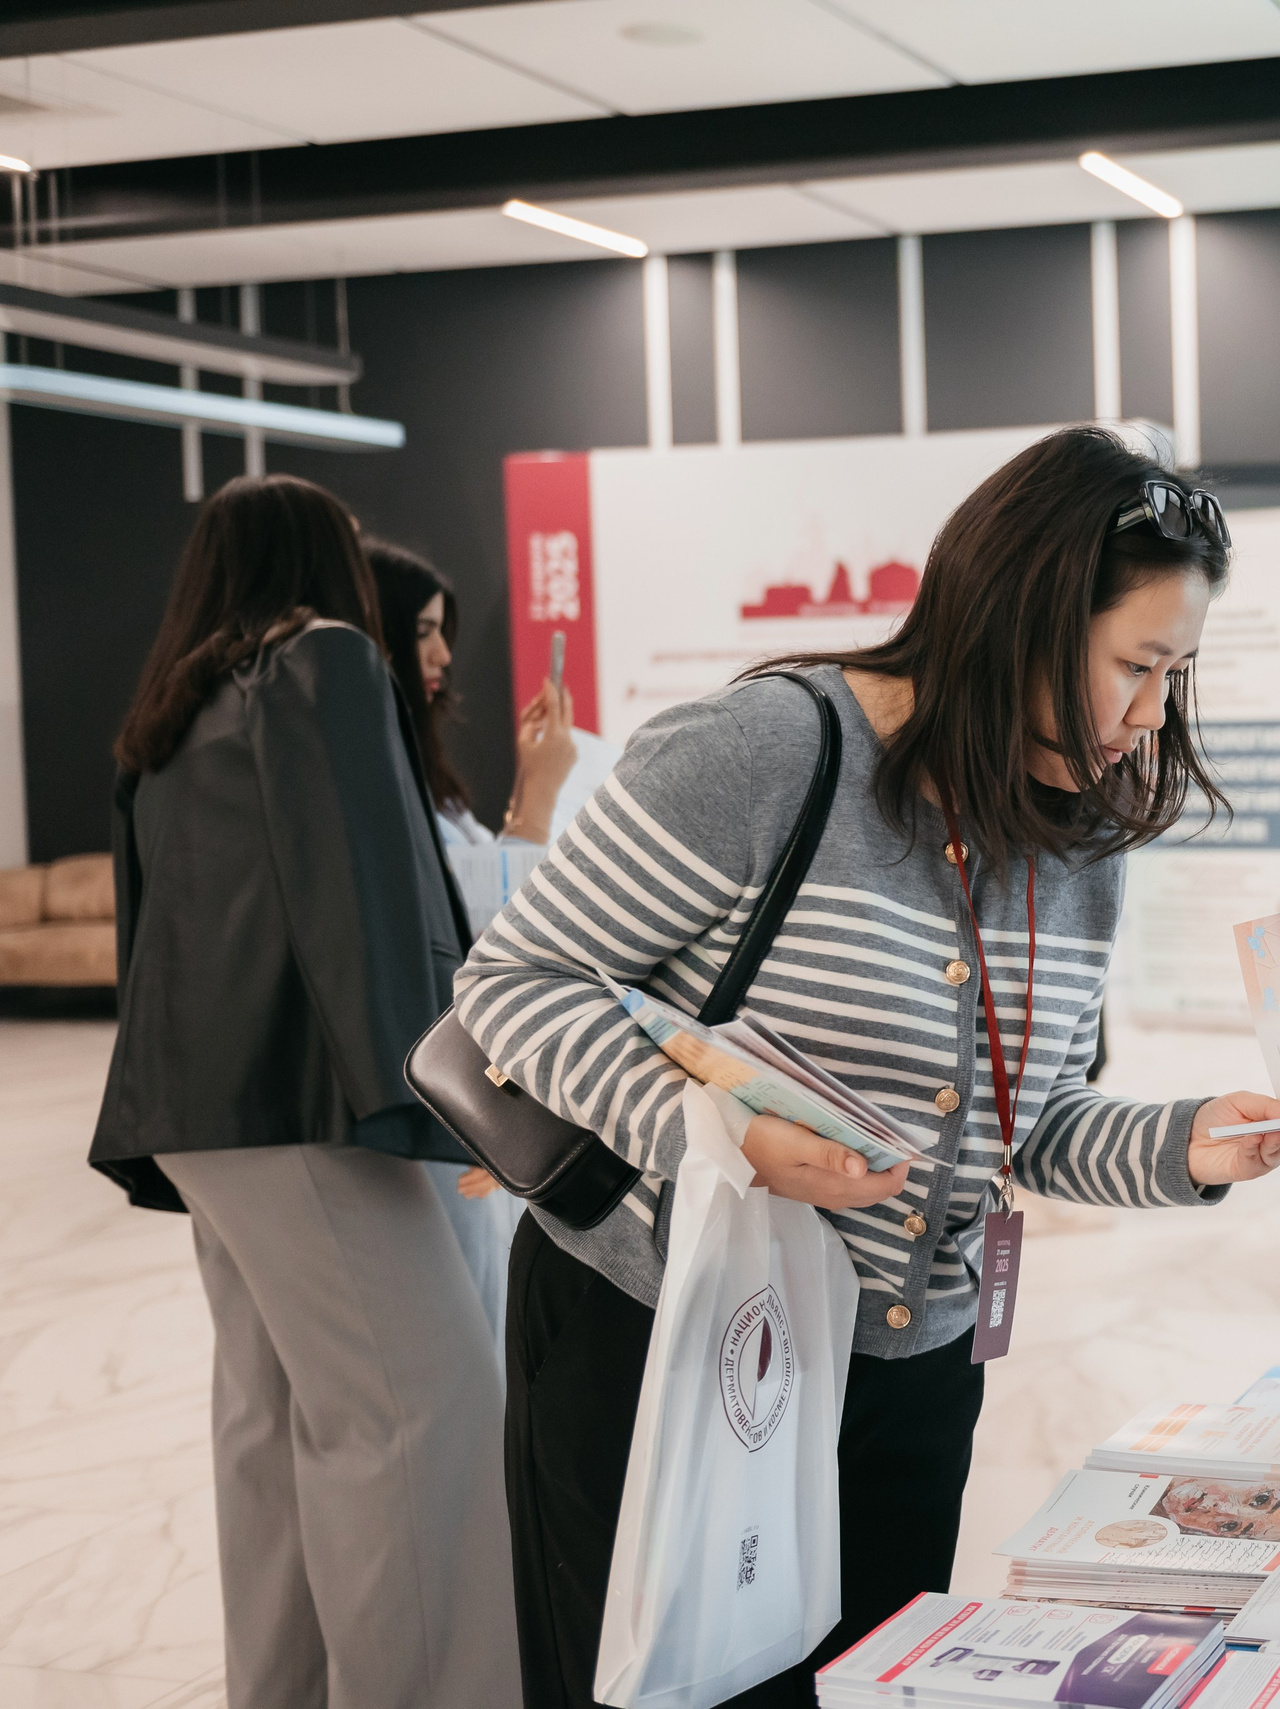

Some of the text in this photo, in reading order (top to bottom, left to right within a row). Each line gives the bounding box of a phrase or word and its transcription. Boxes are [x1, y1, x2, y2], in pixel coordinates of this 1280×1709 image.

[995, 1259, 1009, 1272] 2025
[730, 1294, 784, 1346] НАЦИОН ЛЬЯНС
[1029, 1526, 1058, 1550] ДЕРМАТИТ
